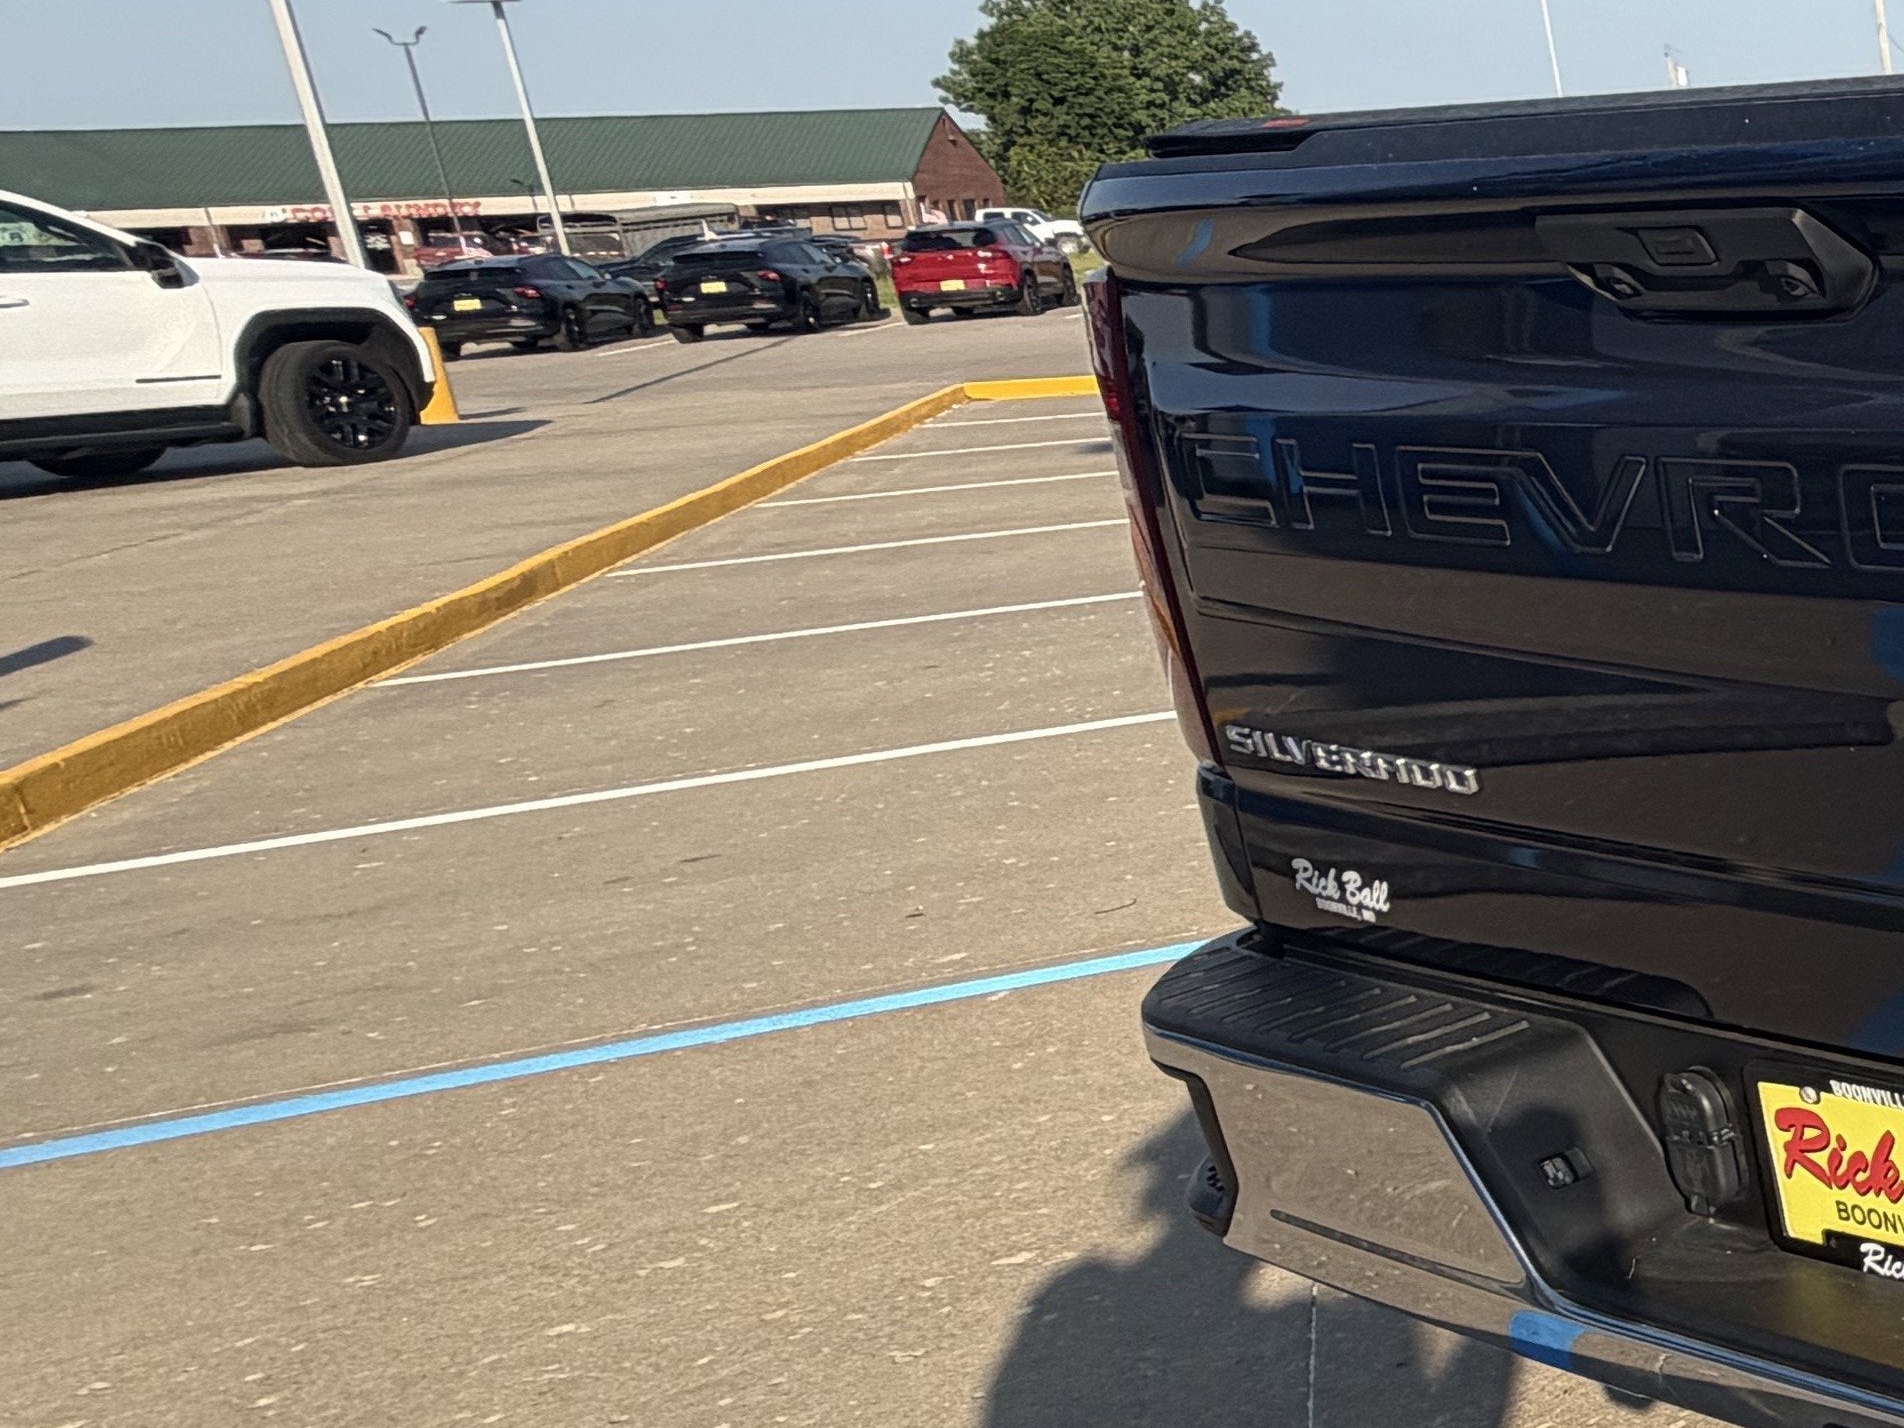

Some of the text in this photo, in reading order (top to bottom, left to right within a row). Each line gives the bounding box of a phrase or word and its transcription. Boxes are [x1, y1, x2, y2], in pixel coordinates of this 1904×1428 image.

[1225, 724, 1480, 795] SILVERADO
[1291, 857, 1341, 900] Rick
[1341, 870, 1391, 913] Ball
